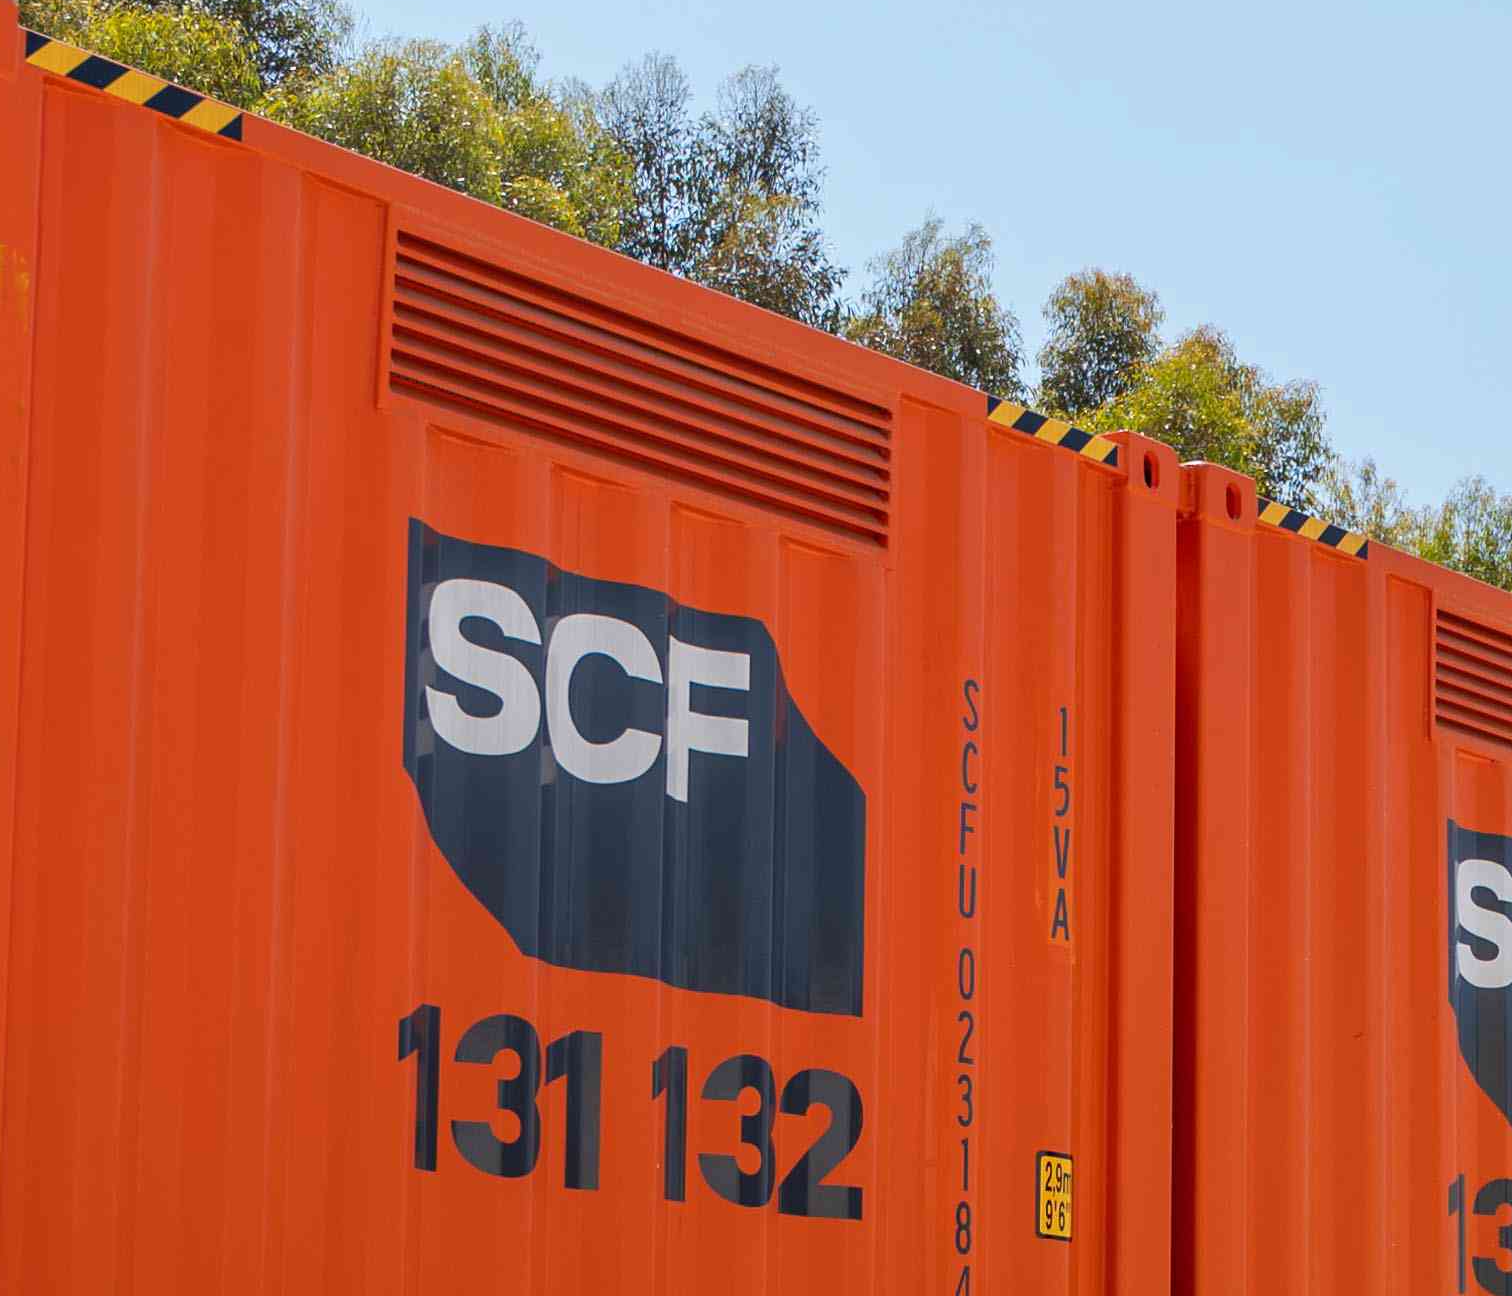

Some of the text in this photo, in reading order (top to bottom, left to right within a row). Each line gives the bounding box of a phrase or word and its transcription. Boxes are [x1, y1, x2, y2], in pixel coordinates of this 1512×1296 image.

[425, 577, 751, 802] SCF
[958, 679, 979, 919] SCFU
[1051, 706, 1070, 942] 15VA
[398, 1004, 863, 1222] 131 132
